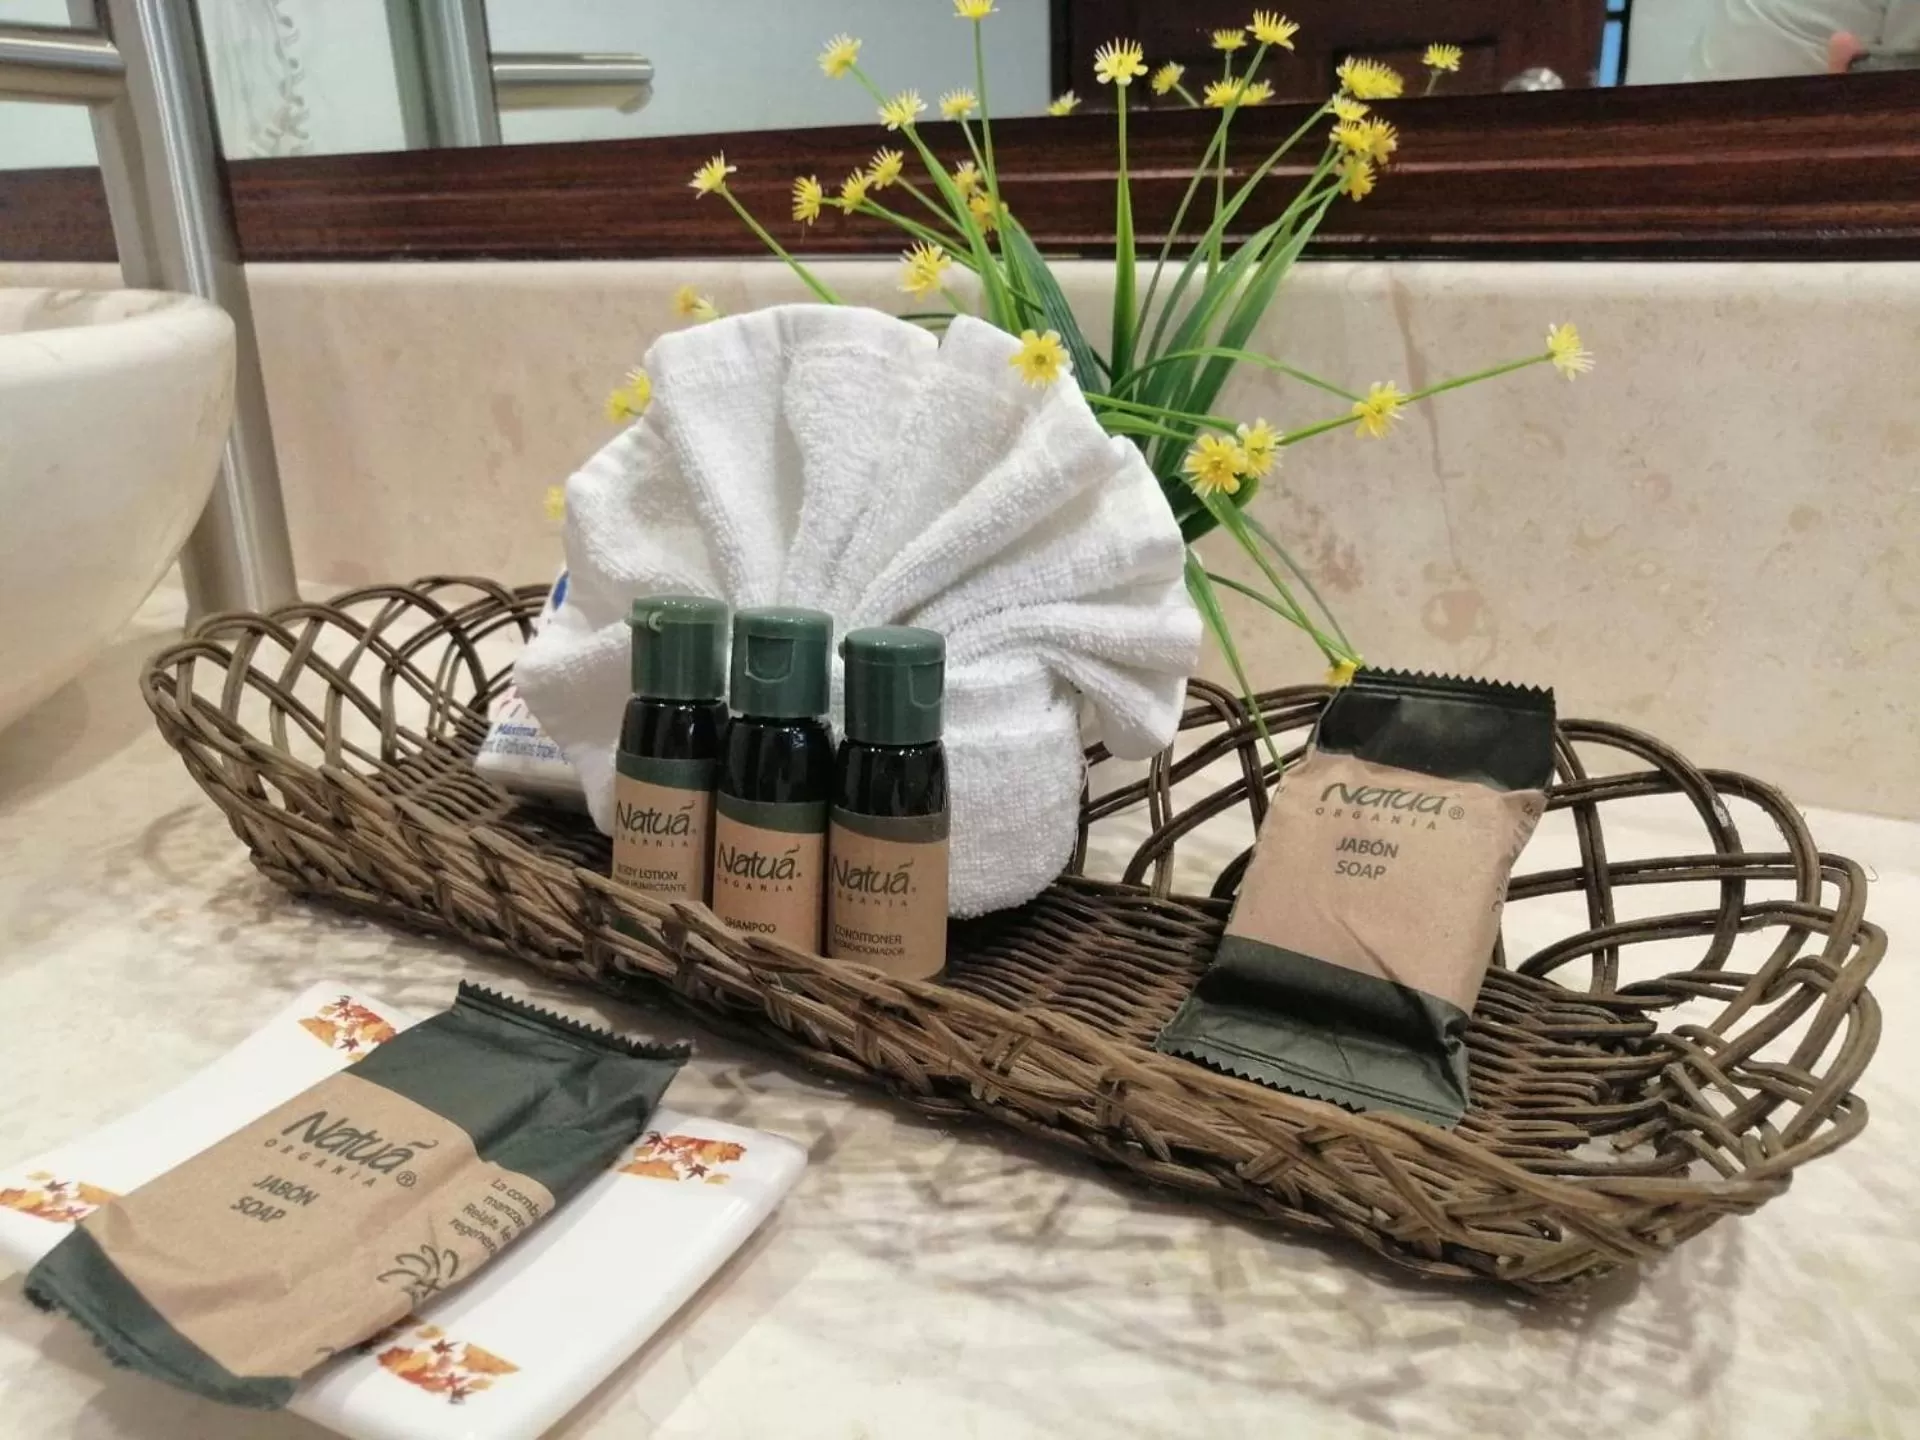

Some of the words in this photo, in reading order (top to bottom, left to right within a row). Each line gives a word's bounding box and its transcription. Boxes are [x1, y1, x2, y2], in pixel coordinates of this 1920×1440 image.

[1315, 807, 1437, 831] ORGANIA
[1336, 837, 1399, 859] JABÓN
[639, 867, 678, 880] LOTION
[1335, 859, 1387, 880] SOAP
[725, 916, 777, 934] SHAMPOO
[834, 924, 902, 944] CONDITIONER
[263, 1138, 378, 1188] ORGANIA
[252, 1174, 320, 1207] JABÓN
[490, 1178, 507, 1193] La
[230, 1196, 287, 1223] SOAP
